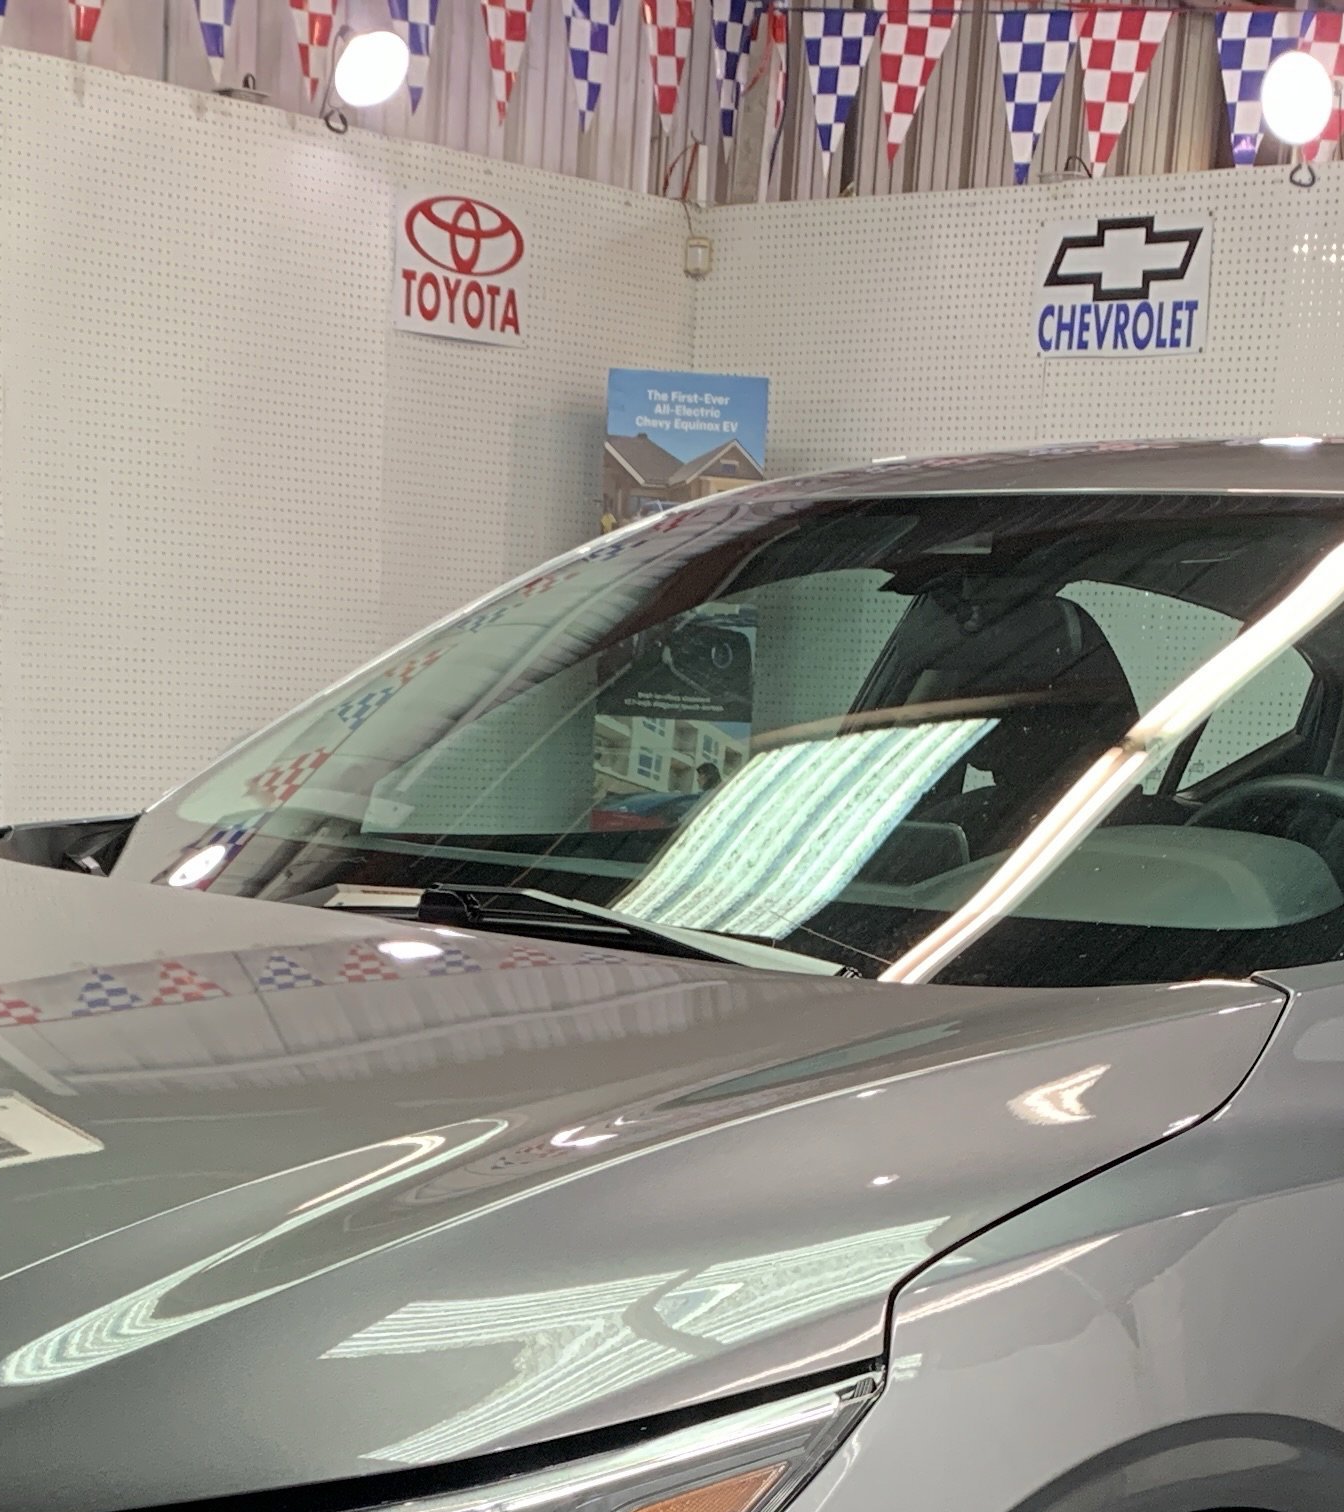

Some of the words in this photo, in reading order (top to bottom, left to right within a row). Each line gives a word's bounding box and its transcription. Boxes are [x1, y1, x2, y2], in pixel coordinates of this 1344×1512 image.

[401, 268, 521, 336] TOYOTA
[1037, 300, 1199, 352] CHEVROLET
[647, 389, 669, 402] The
[671, 391, 730, 406] First-Ever
[654, 403, 721, 419] All-Electric
[635, 415, 672, 431] Chevy
[674, 418, 720, 433] Equinox
[722, 420, 738, 433] EV
